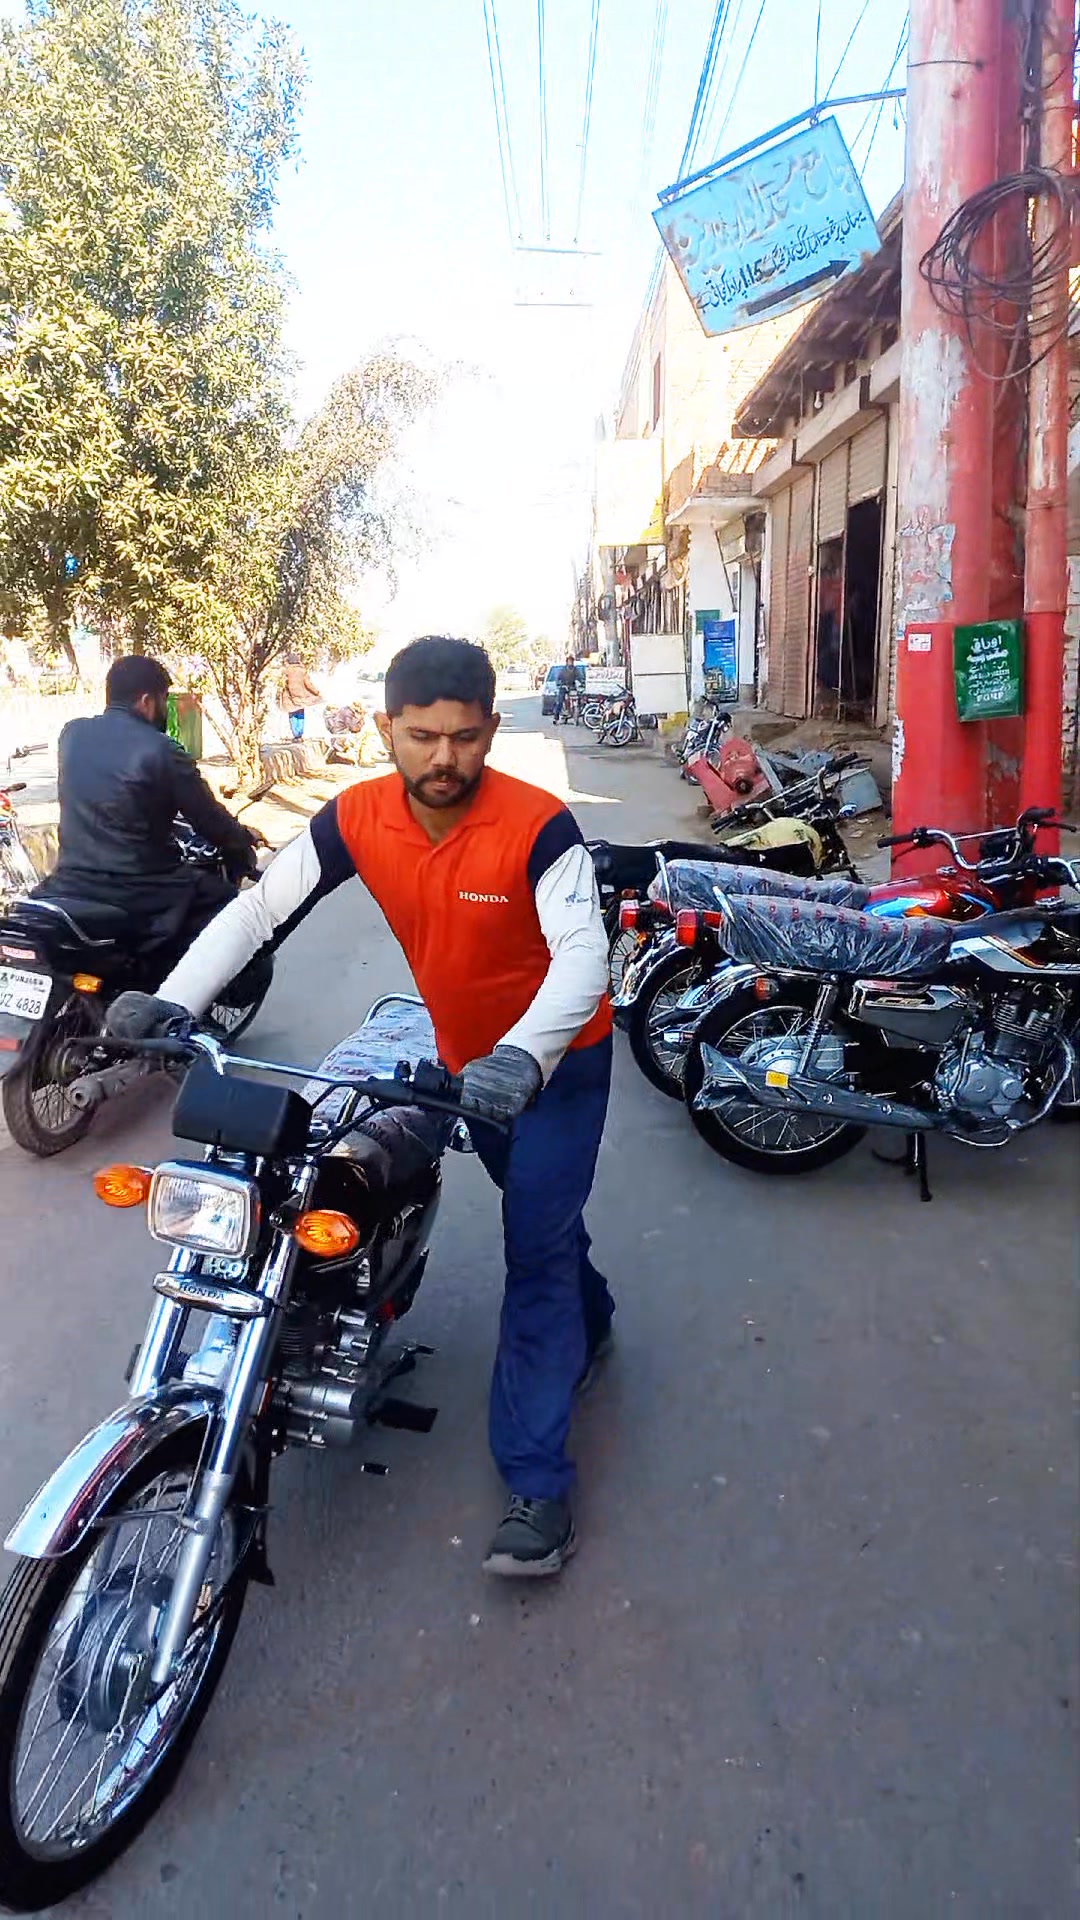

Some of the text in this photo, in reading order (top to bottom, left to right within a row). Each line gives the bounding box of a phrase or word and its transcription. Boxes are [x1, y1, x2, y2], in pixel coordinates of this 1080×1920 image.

[458, 891, 509, 903] HONDA
[16, 998, 42, 1014] 4828
[179, 1282, 225, 1301] HONDA
